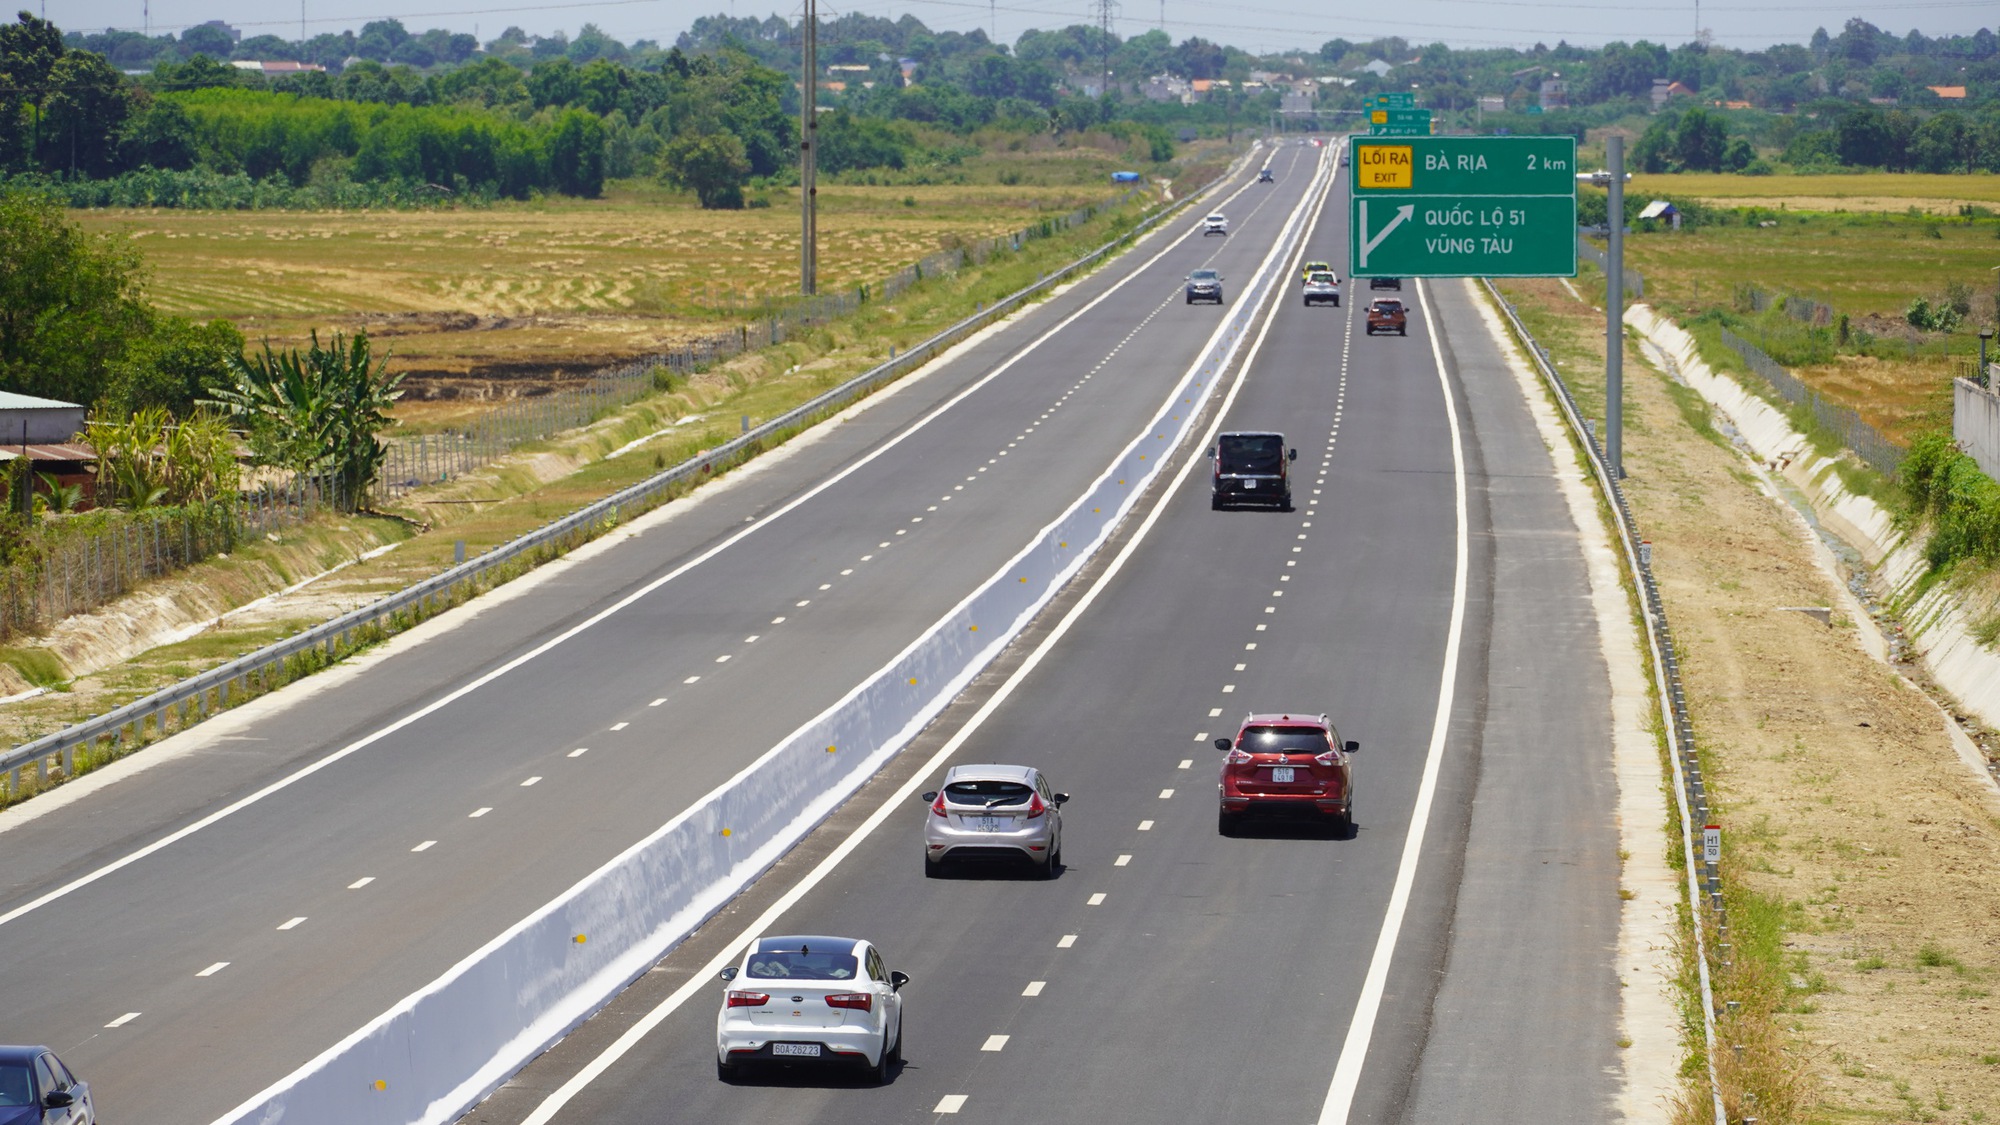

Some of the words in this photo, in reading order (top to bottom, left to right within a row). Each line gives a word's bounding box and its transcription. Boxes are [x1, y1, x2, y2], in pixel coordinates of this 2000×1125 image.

[1363, 149, 1385, 165] LỐI
[1390, 152, 1409, 165] RA
[1425, 150, 1450, 170] BÀ
[1457, 155, 1487, 173] RỊA
[1527, 154, 1537, 170] 2
[1544, 156, 1566, 170] km
[1374, 173, 1397, 182] EXIT
[1425, 203, 1474, 226] QUỐC
[1480, 207, 1503, 229] LỘ
[1509, 210, 1525, 226] 51
[1425, 234, 1475, 254] VŨNG
[1481, 234, 1513, 254] TÀU
[1706, 836, 1718, 844] H1
